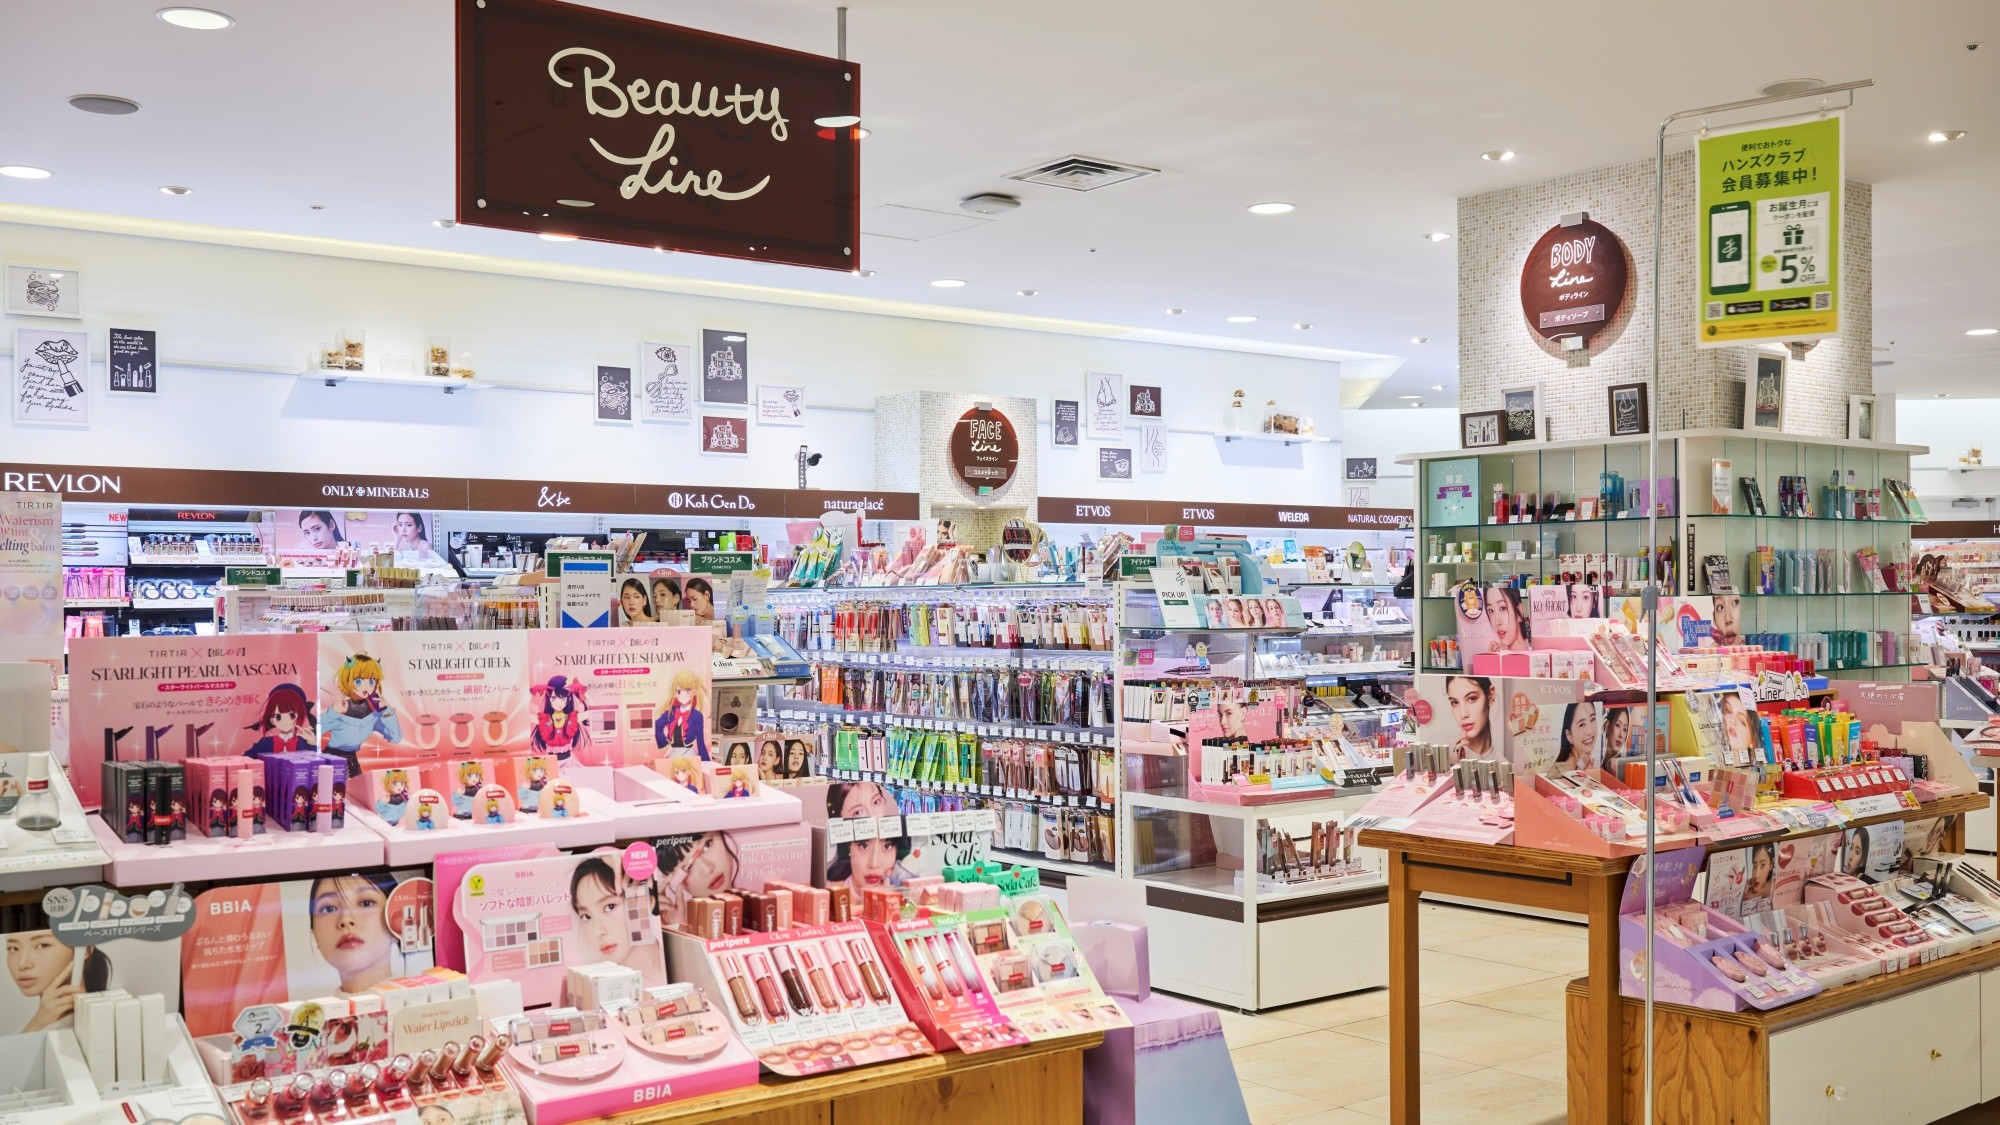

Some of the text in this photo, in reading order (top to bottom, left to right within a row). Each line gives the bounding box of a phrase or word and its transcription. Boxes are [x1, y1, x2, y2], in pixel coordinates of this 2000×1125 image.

[548, 47, 789, 141] Beauty
[1741, 138, 1792, 152] 便利でおトクな
[589, 124, 770, 200] Line
[1722, 148, 1807, 173] ハンズクラブ
[1769, 199, 1819, 213] お誕生月には
[1551, 236, 1596, 269] BODY
[1549, 269, 1593, 288] Line
[1800, 273, 1816, 283] OFF
[1559, 291, 1589, 301] ボディライン
[1554, 311, 1589, 323] ボディソープ
[969, 420, 1002, 440] FACE
[971, 440, 1001, 452] Line
[4, 472, 120, 494] REVLON
[1445, 474, 1463, 484] 限定
[322, 485, 429, 499] ONLY MINERALS
[538, 486, 571, 508] &be
[16, 501, 54, 510] TIRTIR
[685, 493, 755, 510] Koh Gen Do
[824, 497, 884, 511] naturaglacé
[177, 512, 216, 520] REVLON
[1075, 505, 1111, 517] ETVOS
[1183, 508, 1215, 520] ETVOS
[1278, 511, 1309, 523] WELEDA
[0, 514, 54, 526] Waterism
[109, 513, 127, 522] NEW
[1348, 514, 1412, 525] NATURAL COSMETICS
[11, 527, 28, 537] tint
[0, 537, 55, 554] elting balm
[700, 555, 742, 564] ブランドコスメ
[235, 569, 272, 577] ブランドコスメ
[421, 643, 453, 651] TIRTIR
[149, 650, 187, 658] TIRTIR
[555, 653, 618, 666] STARLIGHT
[408, 657, 511, 670] STARLIGHT CHEEK
[91, 663, 298, 682] STARLIGHT PEARL MASCARA
[1541, 685, 1571, 695] ETVOS
[1760, 689, 1781, 699] Liner
[206, 694, 260, 706] きらめき輝く
[656, 835, 693, 848] peripera
[631, 851, 648, 859] NEW
[515, 871, 534, 879] BBIA
[47, 896, 68, 904] SNS
[479, 893, 571, 912] ソフトな陰影パレット
[210, 899, 252, 915] BBIA
[83, 924, 162, 937] ベースITEMシリーズ
[709, 936, 750, 951] peripera
[403, 1016, 470, 1035] Water Lipstick
[552, 1024, 570, 1032] SAMPLE
[560, 1046, 579, 1054] SAMPLE
[633, 1084, 672, 1103] BBIA
